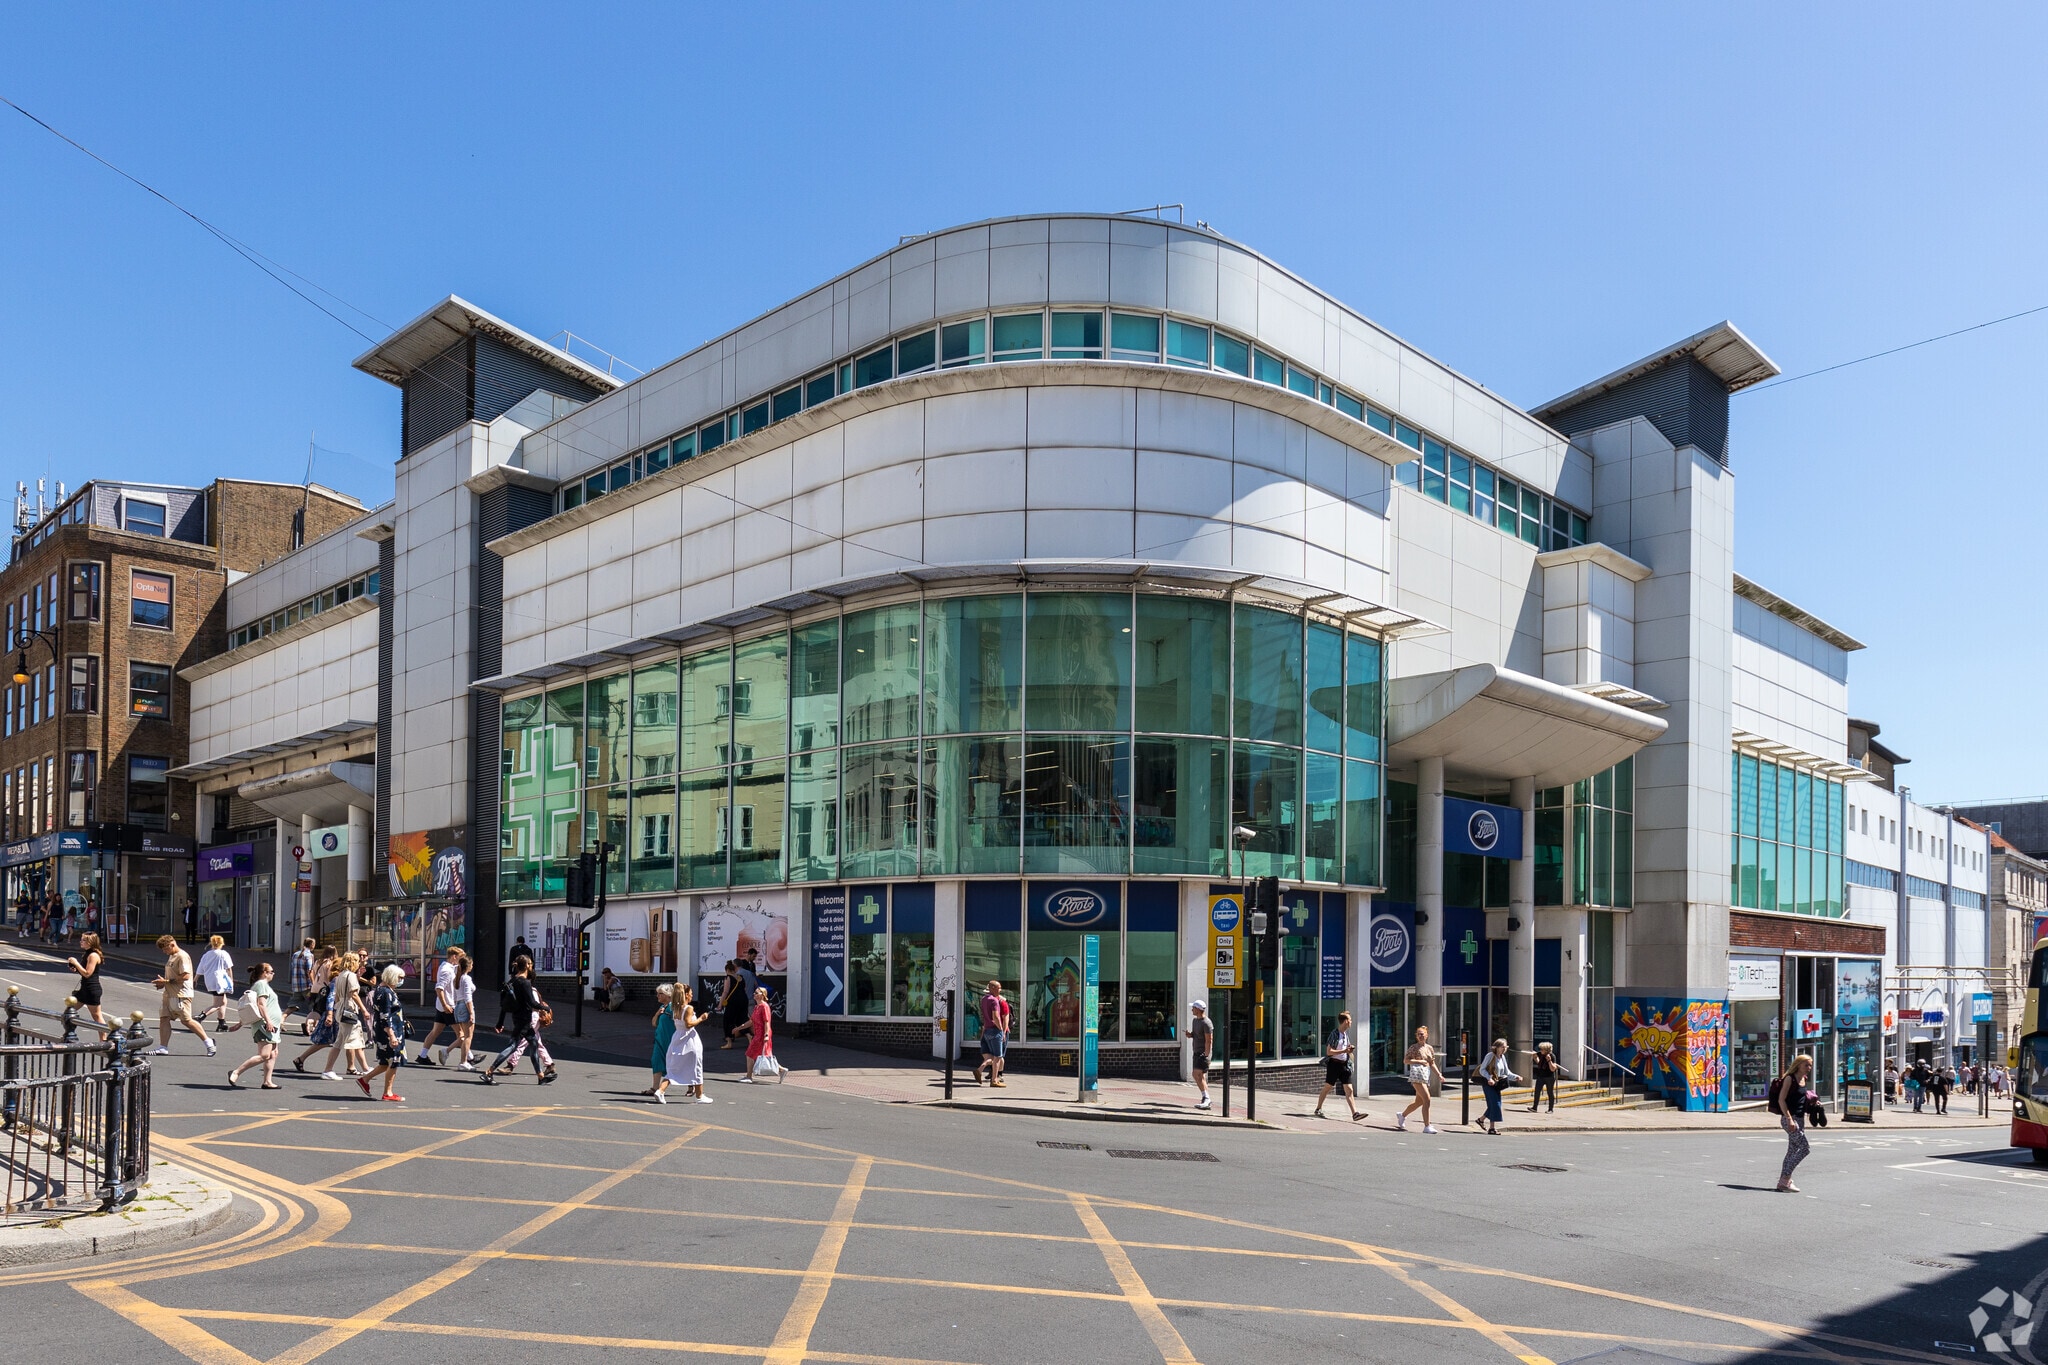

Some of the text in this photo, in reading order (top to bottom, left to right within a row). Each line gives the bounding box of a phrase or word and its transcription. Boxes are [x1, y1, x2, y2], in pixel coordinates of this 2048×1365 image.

[136, 582, 167, 594] OptaNet
[814, 896, 845, 905] welcome
[1053, 896, 1095, 917] Boots
[1372, 928, 1403, 957] Boots
[1631, 1027, 1679, 1053] POP!
